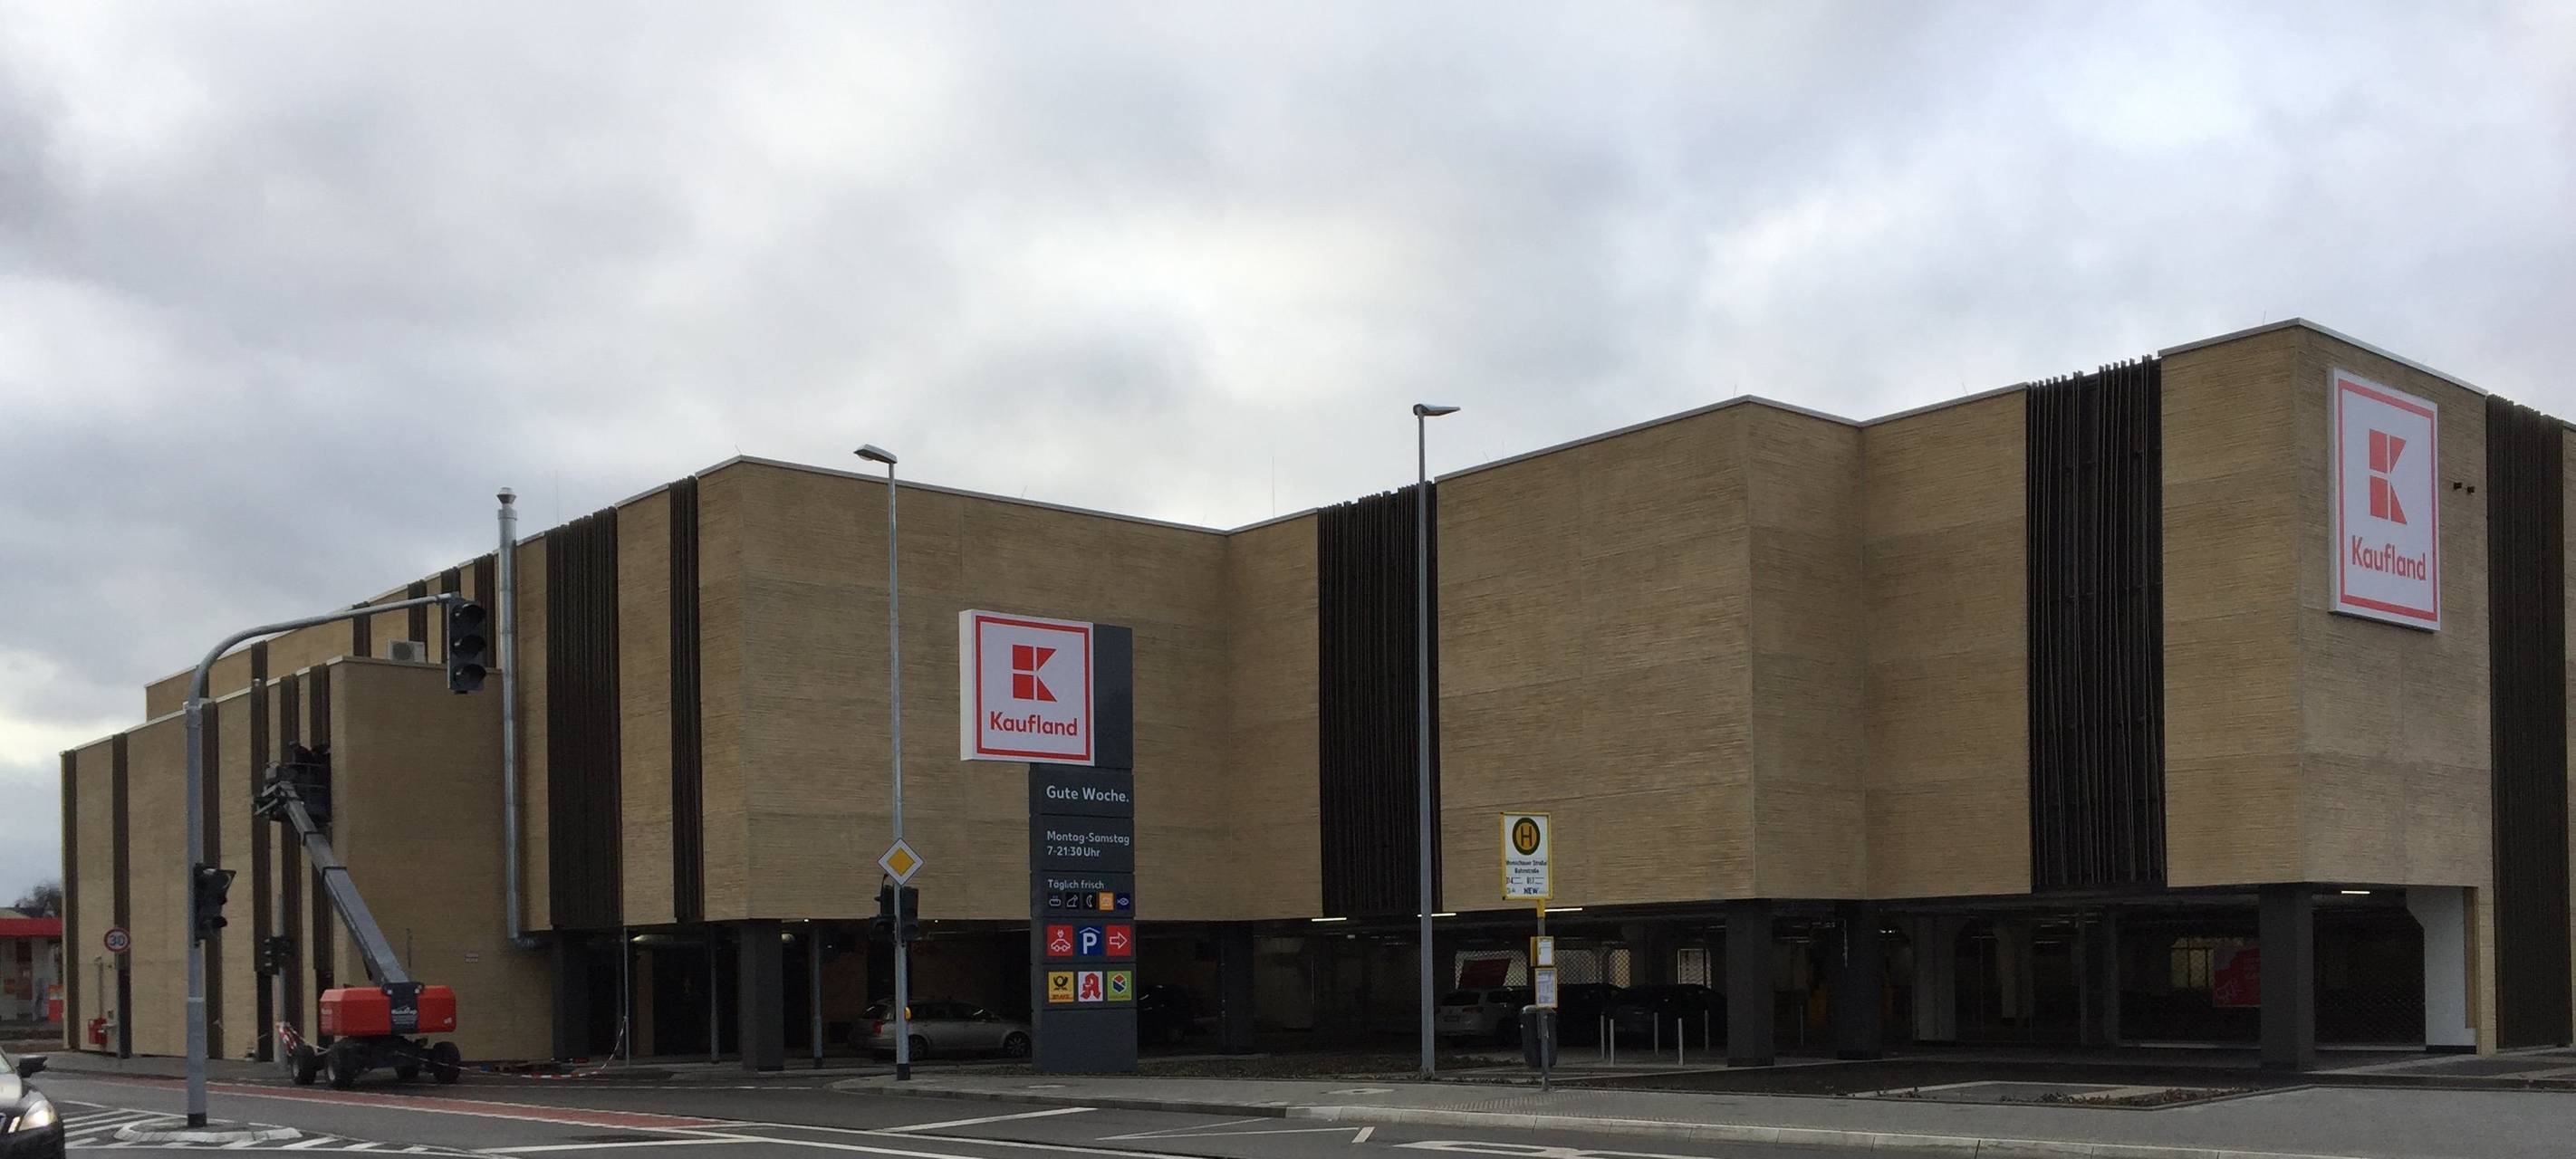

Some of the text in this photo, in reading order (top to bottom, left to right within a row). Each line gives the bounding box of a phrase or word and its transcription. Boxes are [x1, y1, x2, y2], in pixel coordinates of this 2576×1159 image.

[2351, 535, 2427, 581] Kaufland
[990, 711, 1078, 736] Kaufland
[1046, 785, 1129, 802] Gute Woche.
[1047, 830, 1130, 846] Montag-Samstag
[1521, 825, 1533, 847] H
[1083, 847, 1101, 857] Uhr
[1047, 879, 1105, 890] Täglich frisch
[110, 934, 125, 946] 30
[1082, 932, 1098, 955] P
